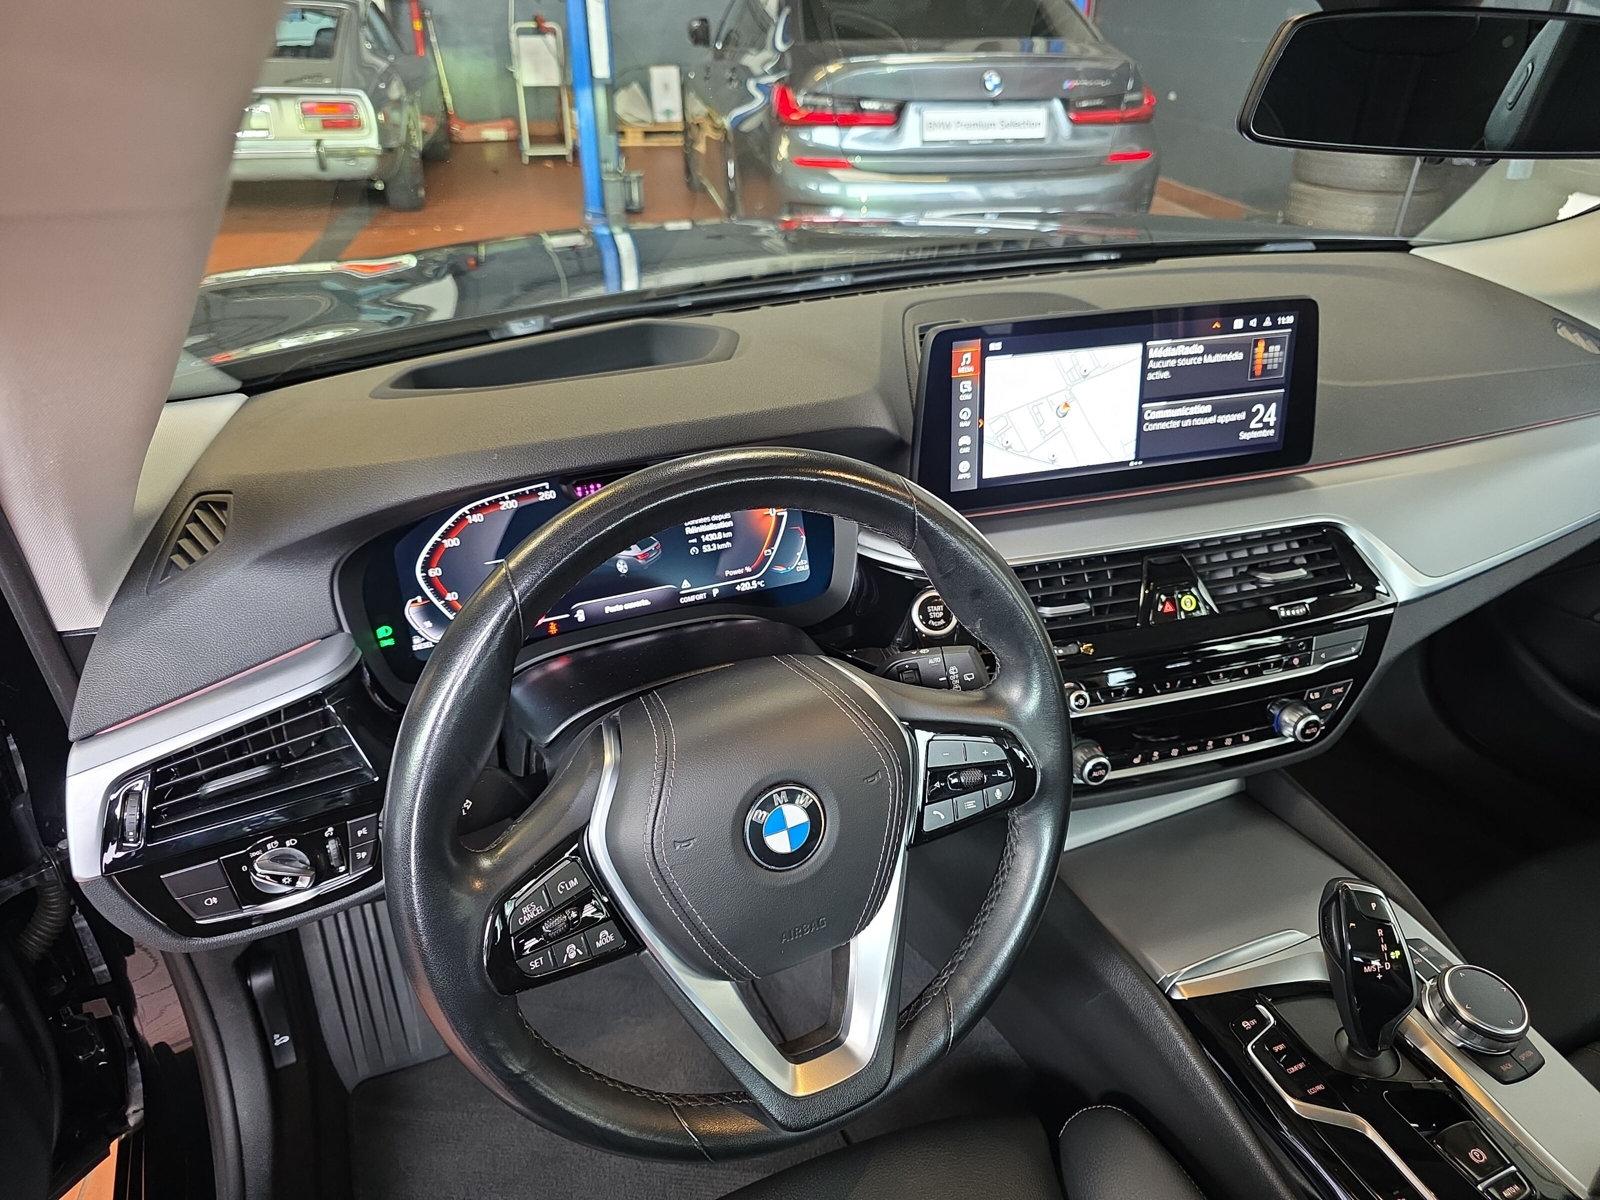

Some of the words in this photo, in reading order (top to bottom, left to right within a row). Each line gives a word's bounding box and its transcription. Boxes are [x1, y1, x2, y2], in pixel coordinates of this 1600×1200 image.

[956, 120, 996, 131] Premium
[1000, 119, 1041, 129] Selection
[1147, 357, 1177, 369] Aucune
[1176, 355, 1203, 367] source
[1203, 351, 1244, 364] Multimédia
[1146, 370, 1172, 381] active.
[1143, 404, 1212, 420] Communication
[1249, 402, 1277, 429] 24
[1142, 418, 1181, 432] Connecter
[1181, 418, 1192, 427] un
[1192, 414, 1217, 427] nouvel
[1217, 411, 1247, 424] appareil
[1238, 428, 1275, 441] Septembre
[538, 490, 557, 501] 260
[499, 499, 518, 511] 200
[466, 512, 485, 524] 140
[722, 531, 733, 540] km
[442, 537, 461, 549] 100
[724, 567, 744, 577] Power
[679, 592, 707, 604] COMFORT
[712, 588, 719, 597] P
[929, 611, 944, 619] STOP
[752, 790, 814, 825] BMW
[565, 877, 580, 891] LIM
[522, 901, 537, 916] RES
[517, 904, 546, 926] CANCEL
[781, 917, 828, 943] AIRBAG
[596, 933, 615, 948] MODE
[1381, 944, 1387, 952] N
[528, 956, 545, 971] SET
[1385, 962, 1391, 970] D
[1273, 1043, 1286, 1052] SPORT
[1287, 1062, 1305, 1074] COMFORT
